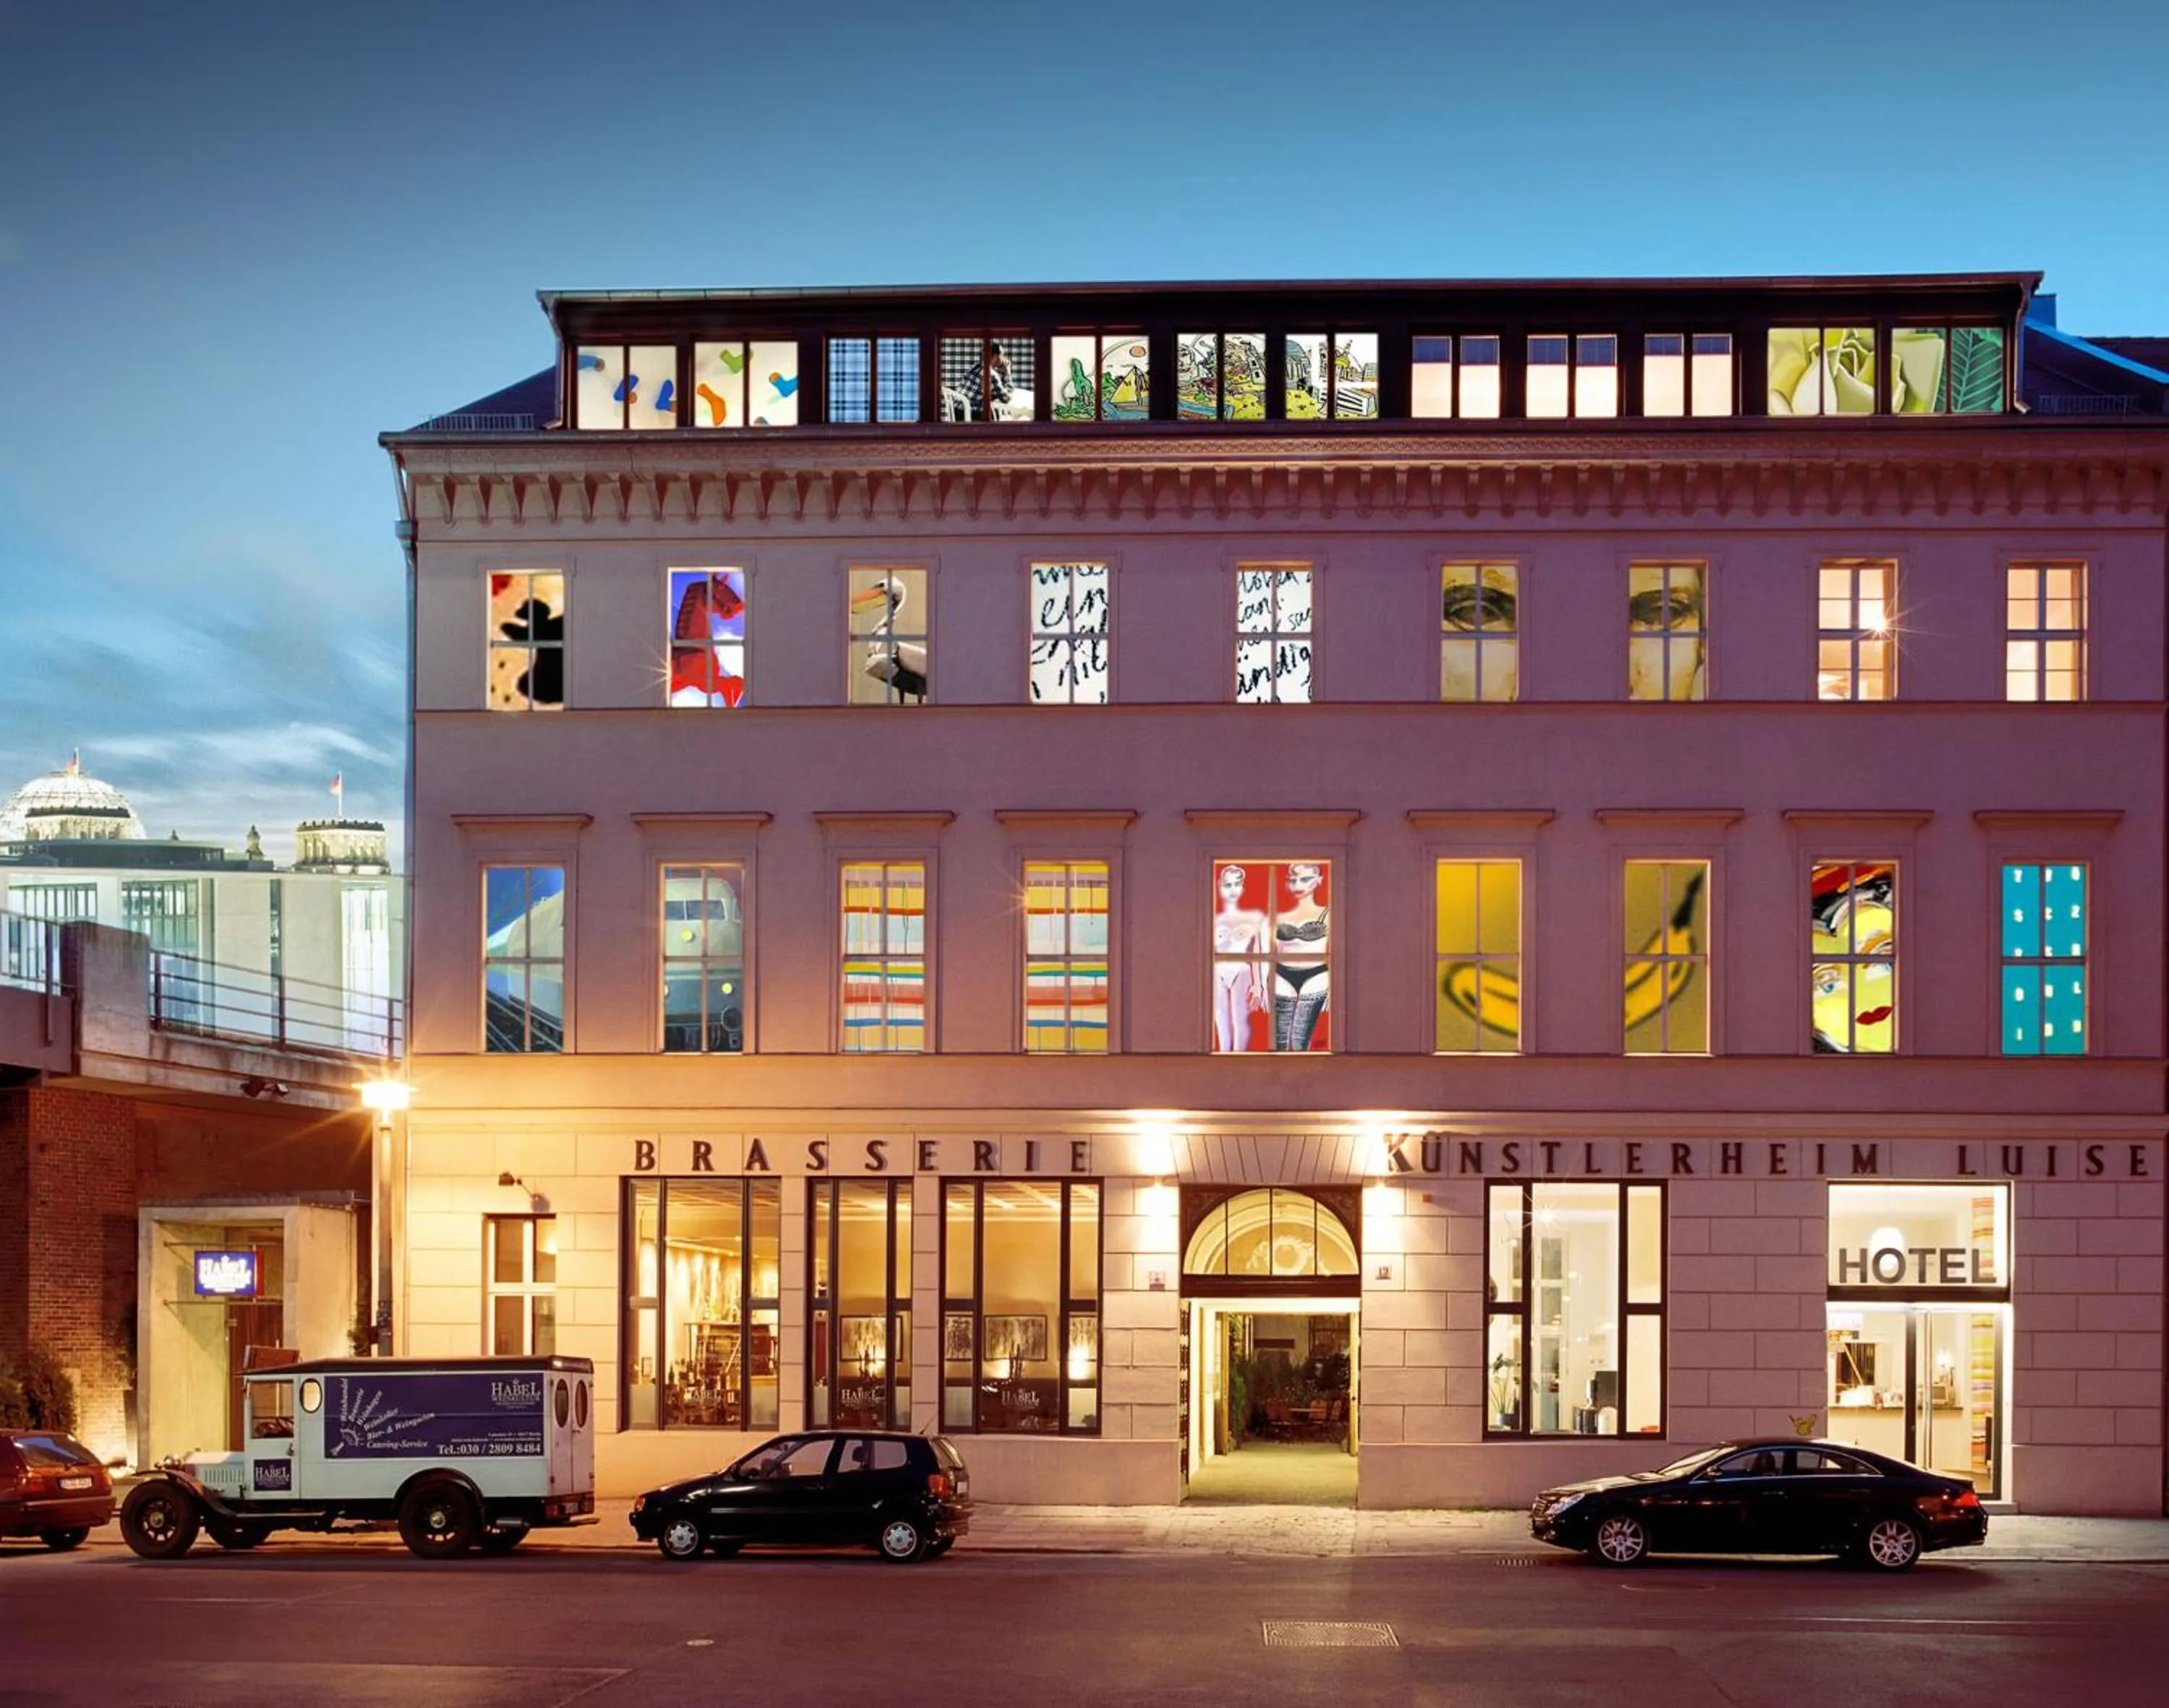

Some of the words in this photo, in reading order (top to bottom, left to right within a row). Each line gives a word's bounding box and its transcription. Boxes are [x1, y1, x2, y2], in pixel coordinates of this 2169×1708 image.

[633, 1138, 1091, 1171] BRASSERIE
[1383, 1132, 1879, 1175] KÜNSTLERHEIM
[1956, 1145, 2148, 1176] LUISE
[1839, 1247, 1997, 1284] HOTEL
[489, 1444, 513, 1454] 2809
[515, 1443, 541, 1453] 8484
